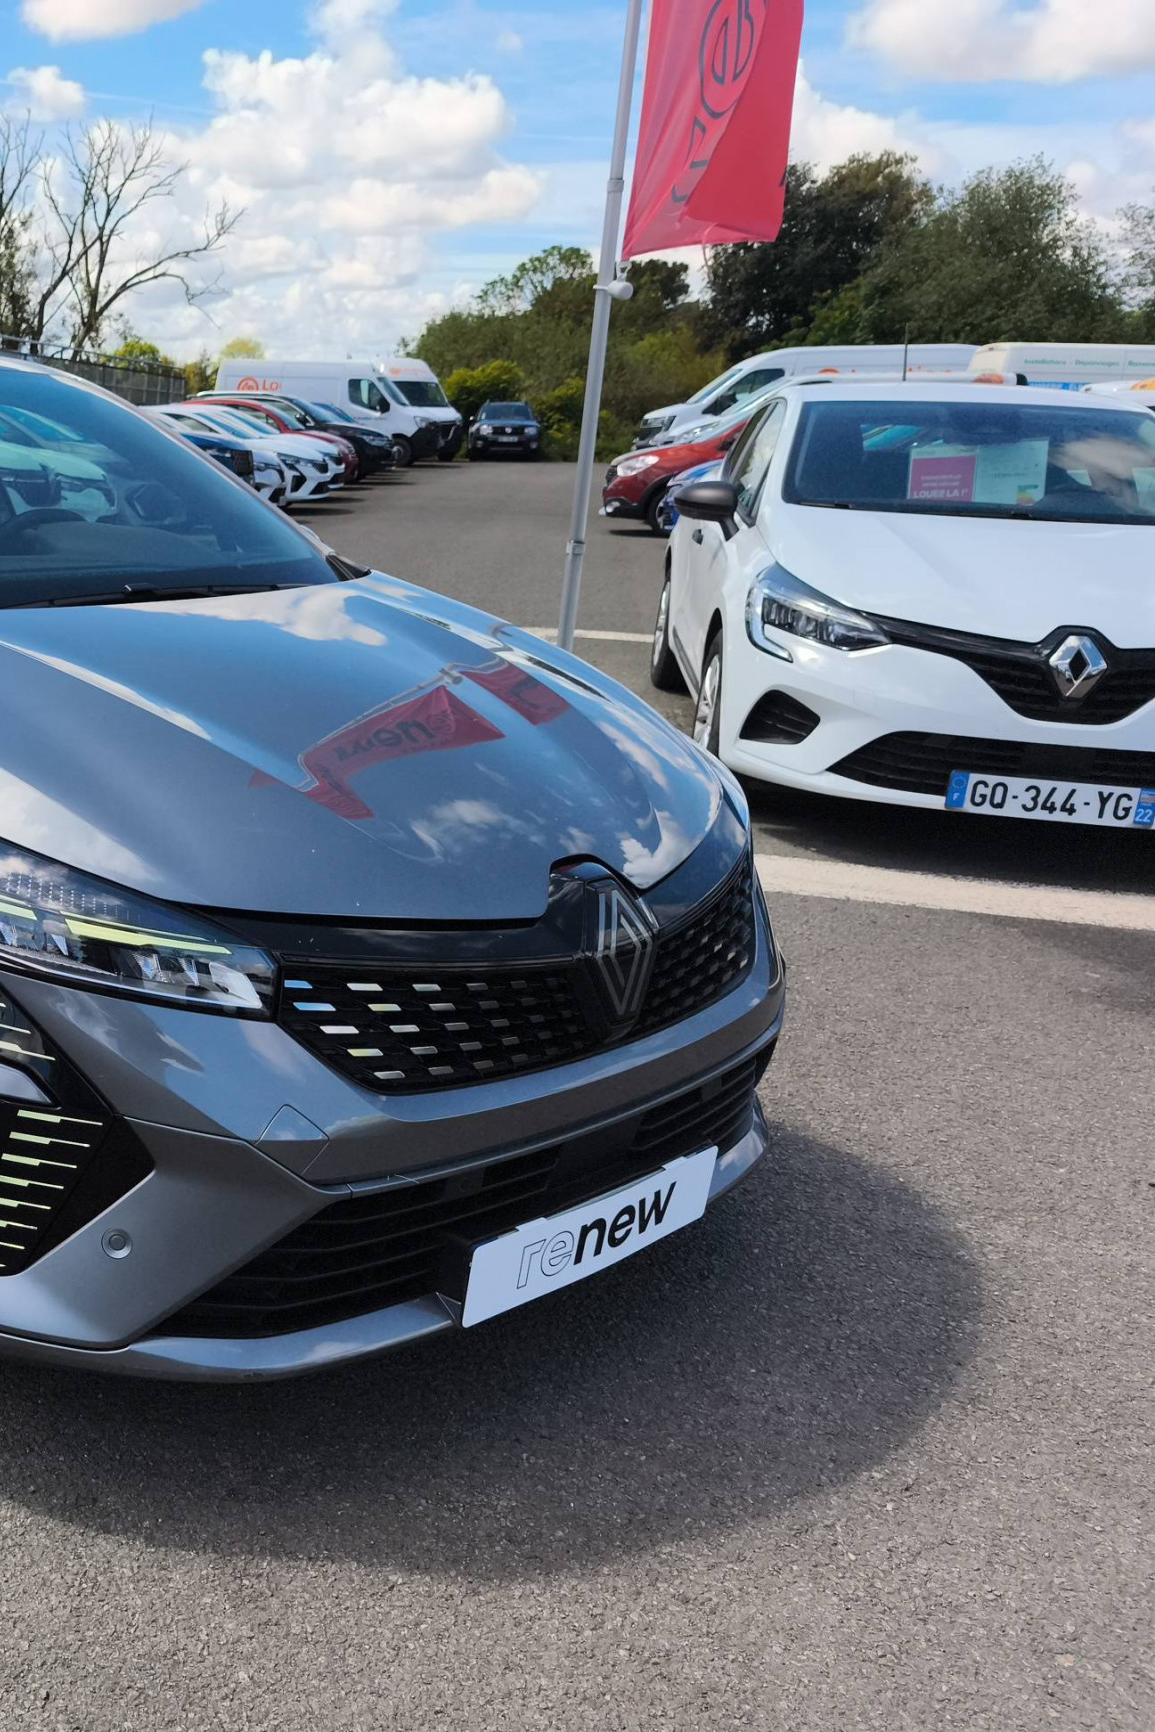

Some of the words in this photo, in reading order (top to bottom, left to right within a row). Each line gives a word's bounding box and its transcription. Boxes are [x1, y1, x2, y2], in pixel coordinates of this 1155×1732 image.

[952, 792, 959, 801] F
[969, 780, 1134, 821] GQ-344-YG
[1136, 808, 1153, 823] 22
[516, 1180, 677, 1290] renew
